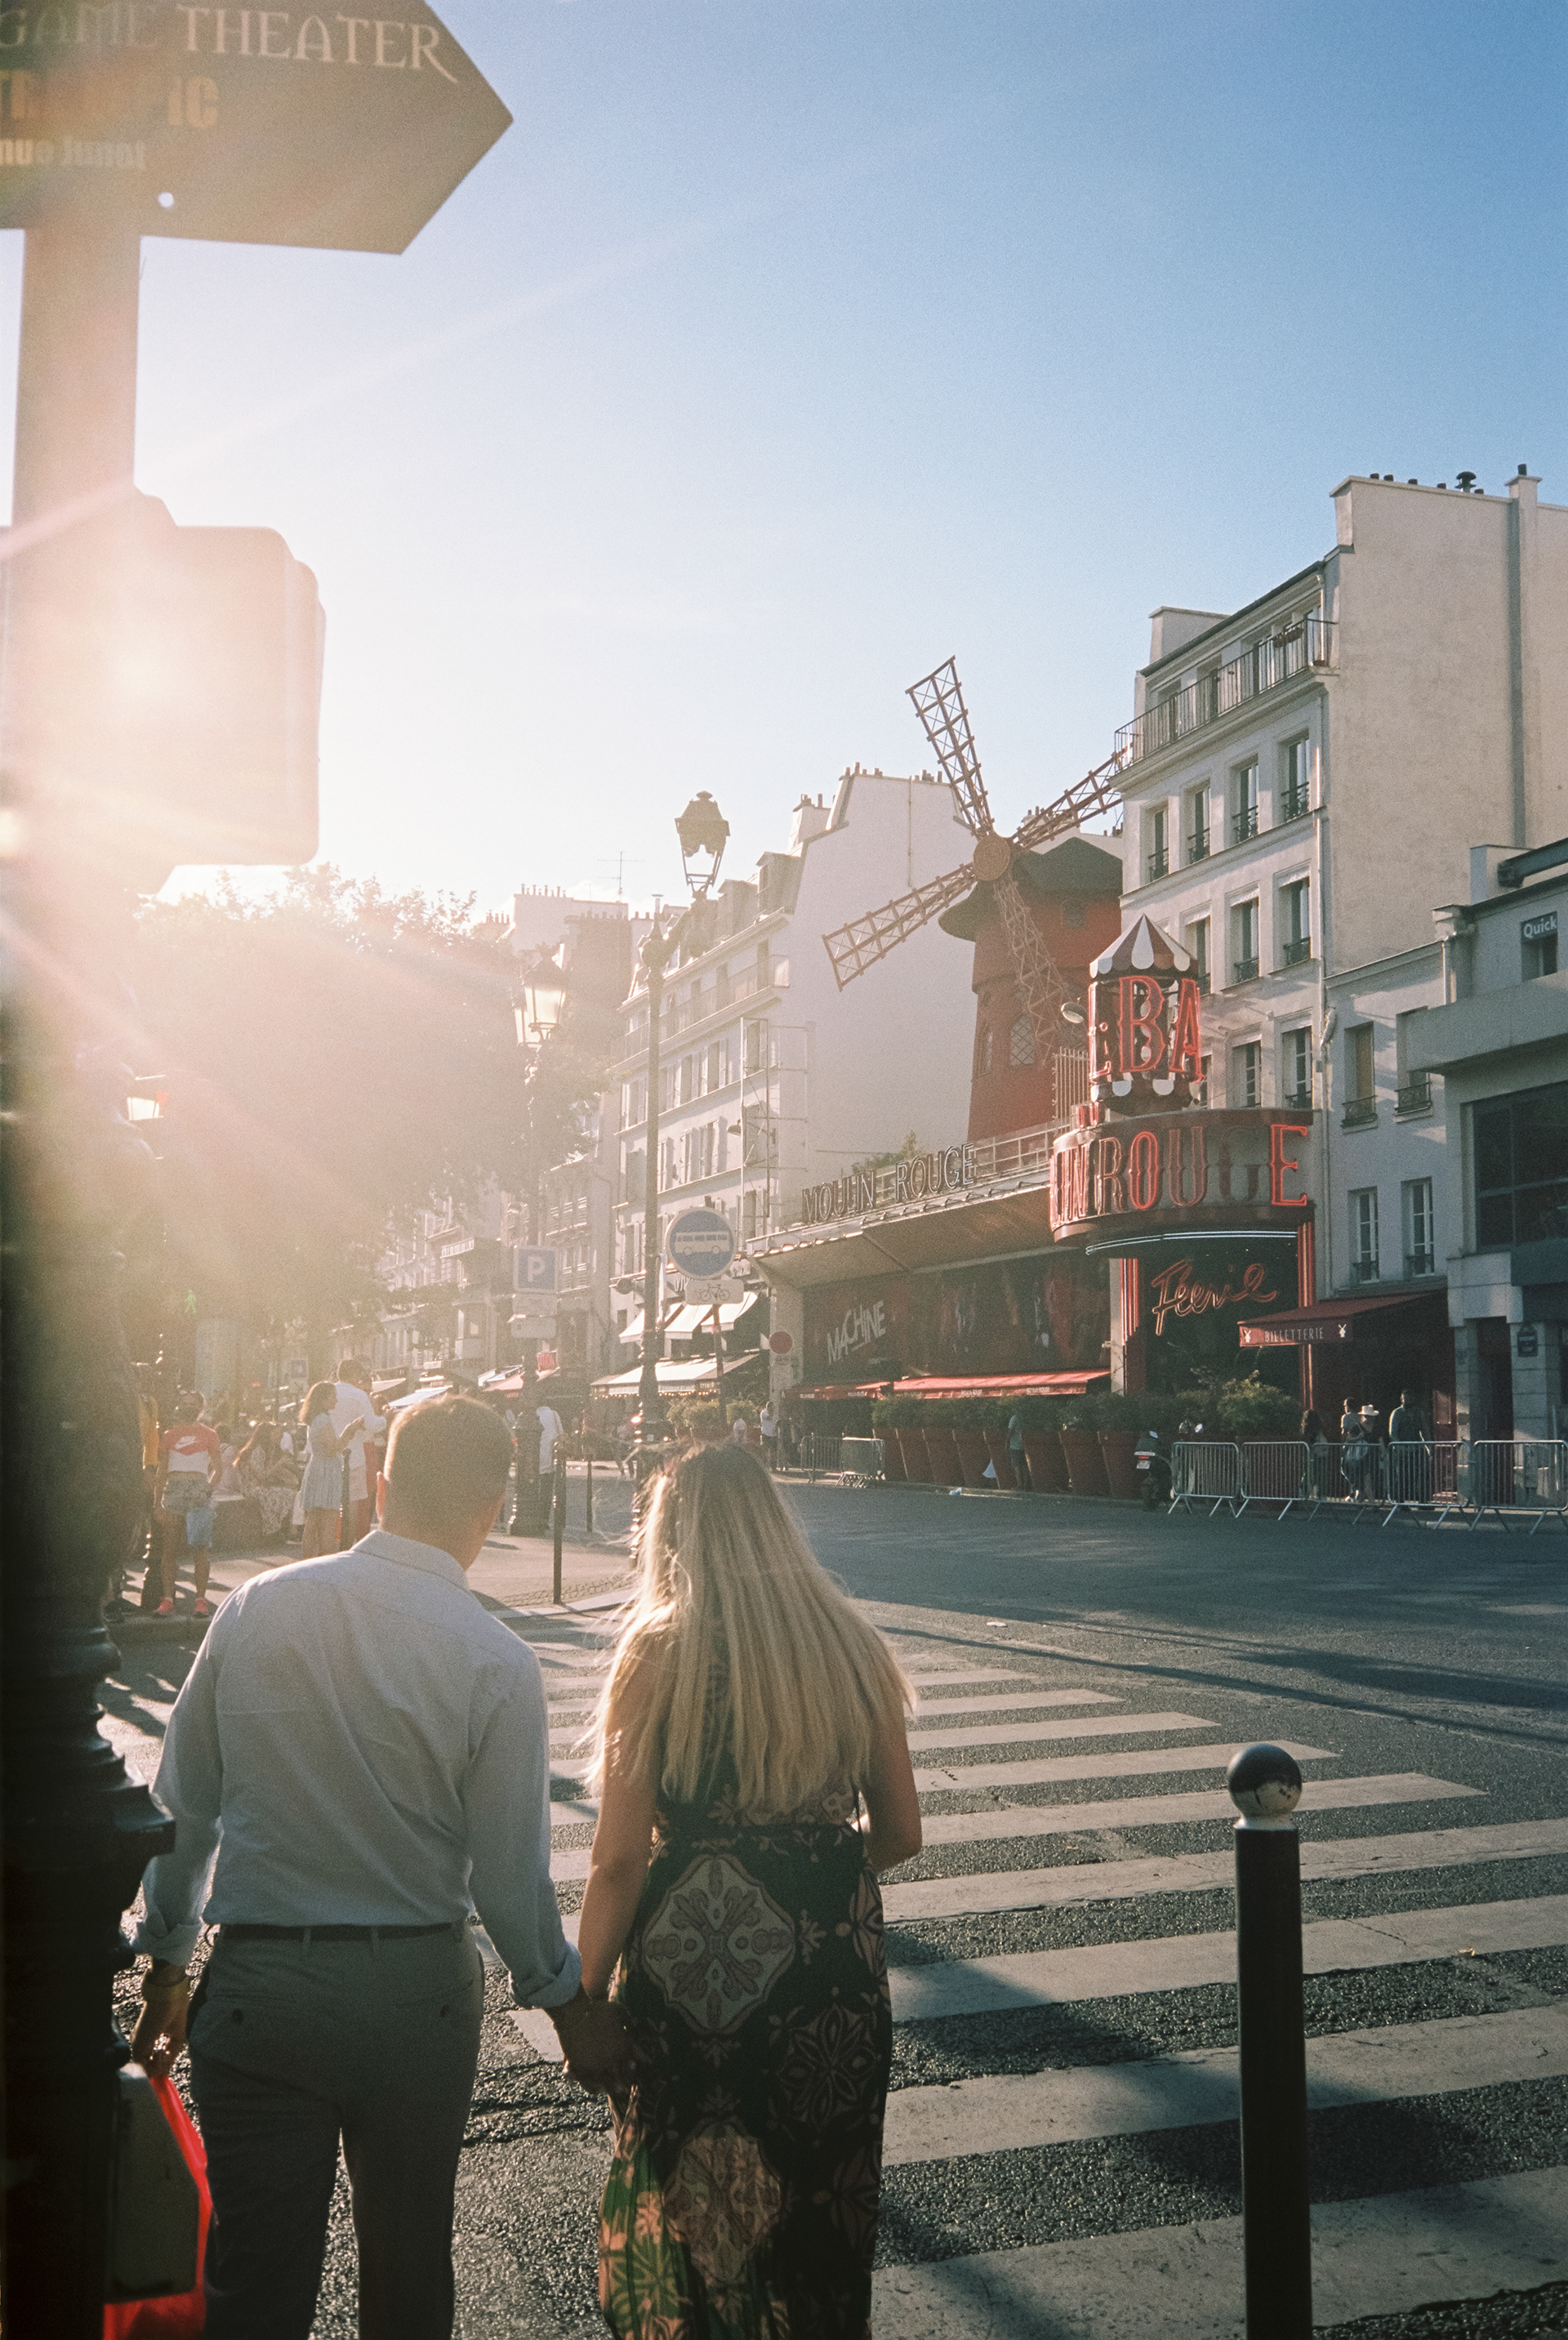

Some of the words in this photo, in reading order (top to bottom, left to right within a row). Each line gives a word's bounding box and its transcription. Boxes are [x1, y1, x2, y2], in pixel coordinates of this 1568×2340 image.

[176, 4, 458, 83] THEATER
[1523, 916, 1557, 939] Quick
[800, 1169, 877, 1224] MOULIN
[895, 1142, 978, 1202] ROUGE
[1094, 1124, 1308, 1215] ROUGE
[527, 1255, 546, 1283] P
[826, 1299, 887, 1366] MACHINE
[1263, 1327, 1325, 1343] BILLETTERIE
